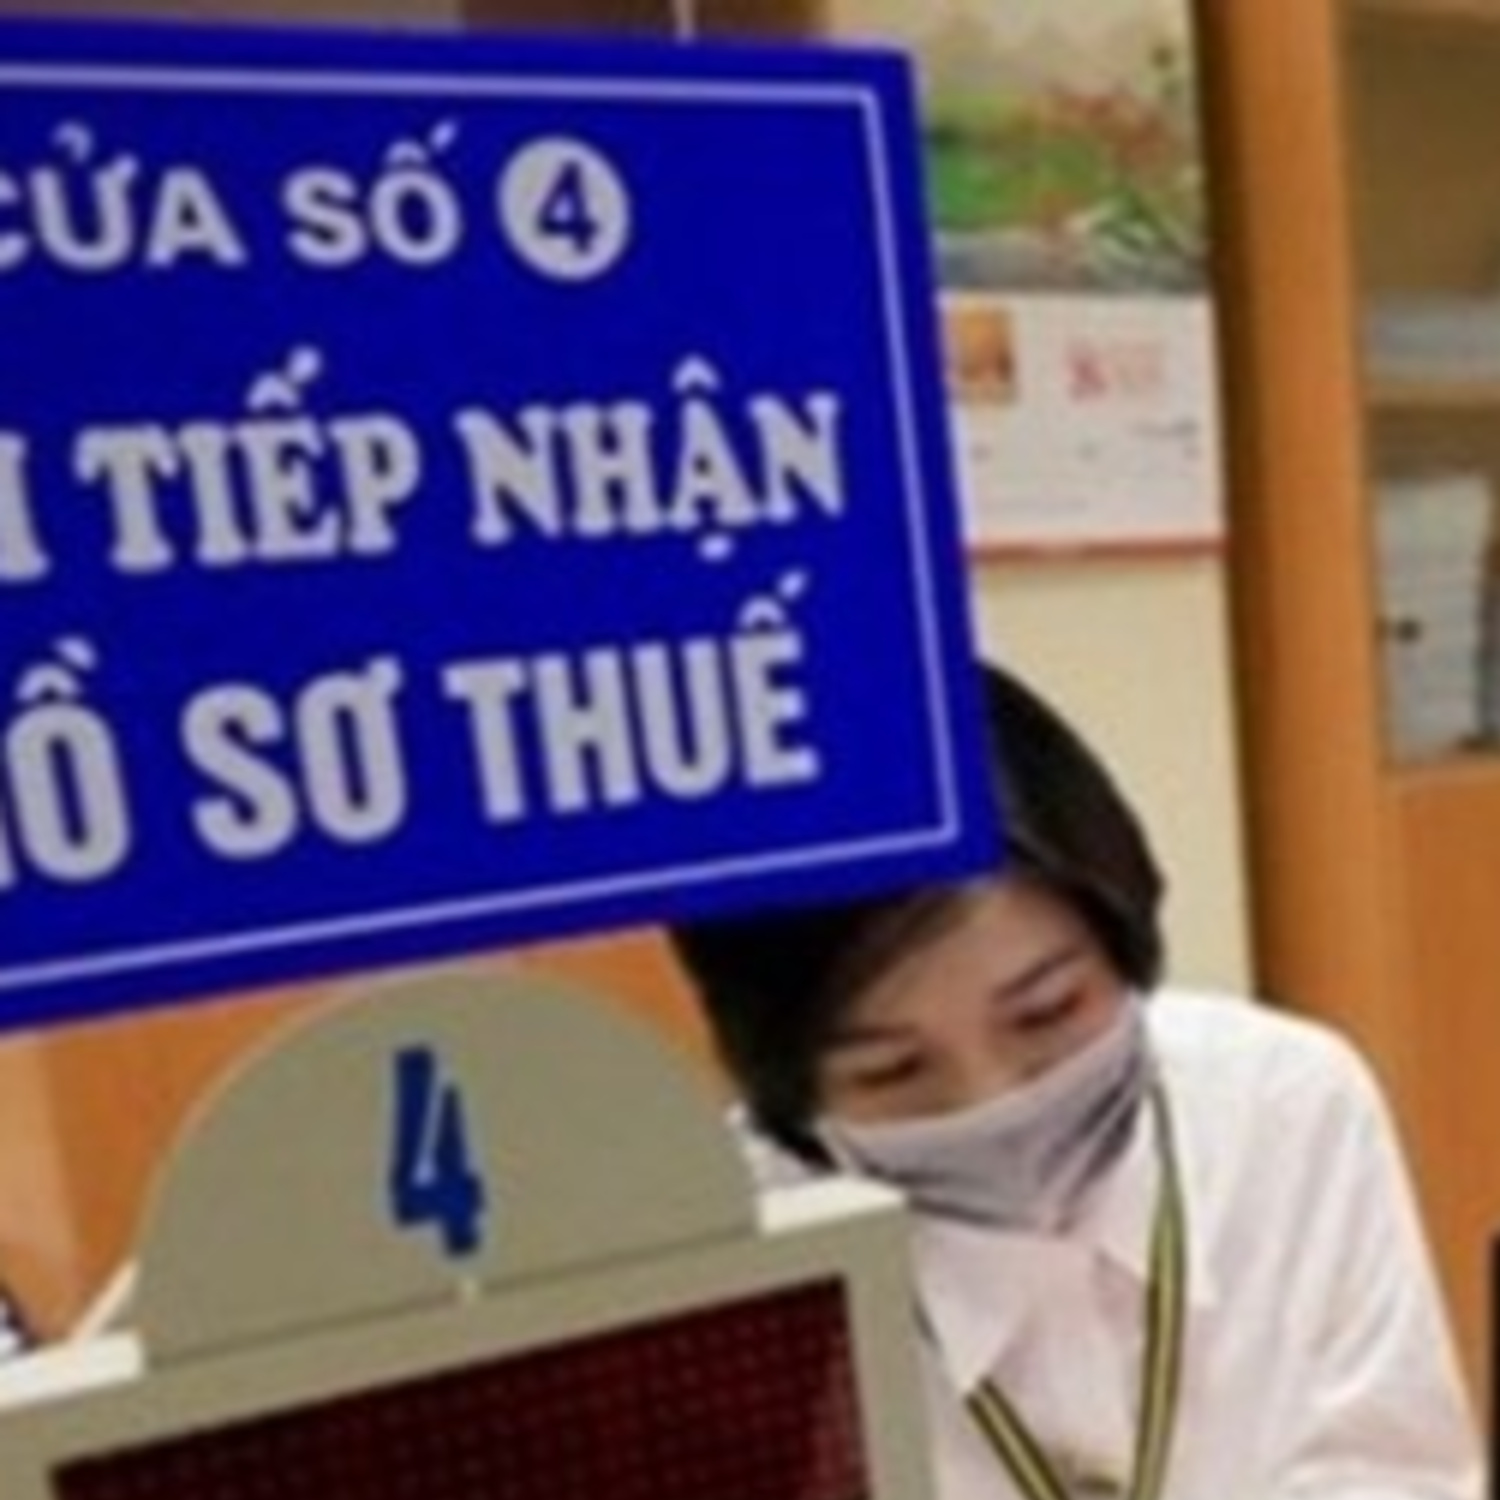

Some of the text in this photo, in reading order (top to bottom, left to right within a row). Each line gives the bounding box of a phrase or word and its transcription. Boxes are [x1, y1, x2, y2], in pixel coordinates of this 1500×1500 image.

[284, 122, 461, 266] SỐ
[74, 347, 421, 572] TIẾP
[455, 356, 843, 560] NHẬN
[0, 571, 820, 888] Ồ SƠ THUẾ
[388, 1045, 485, 1256] 4
